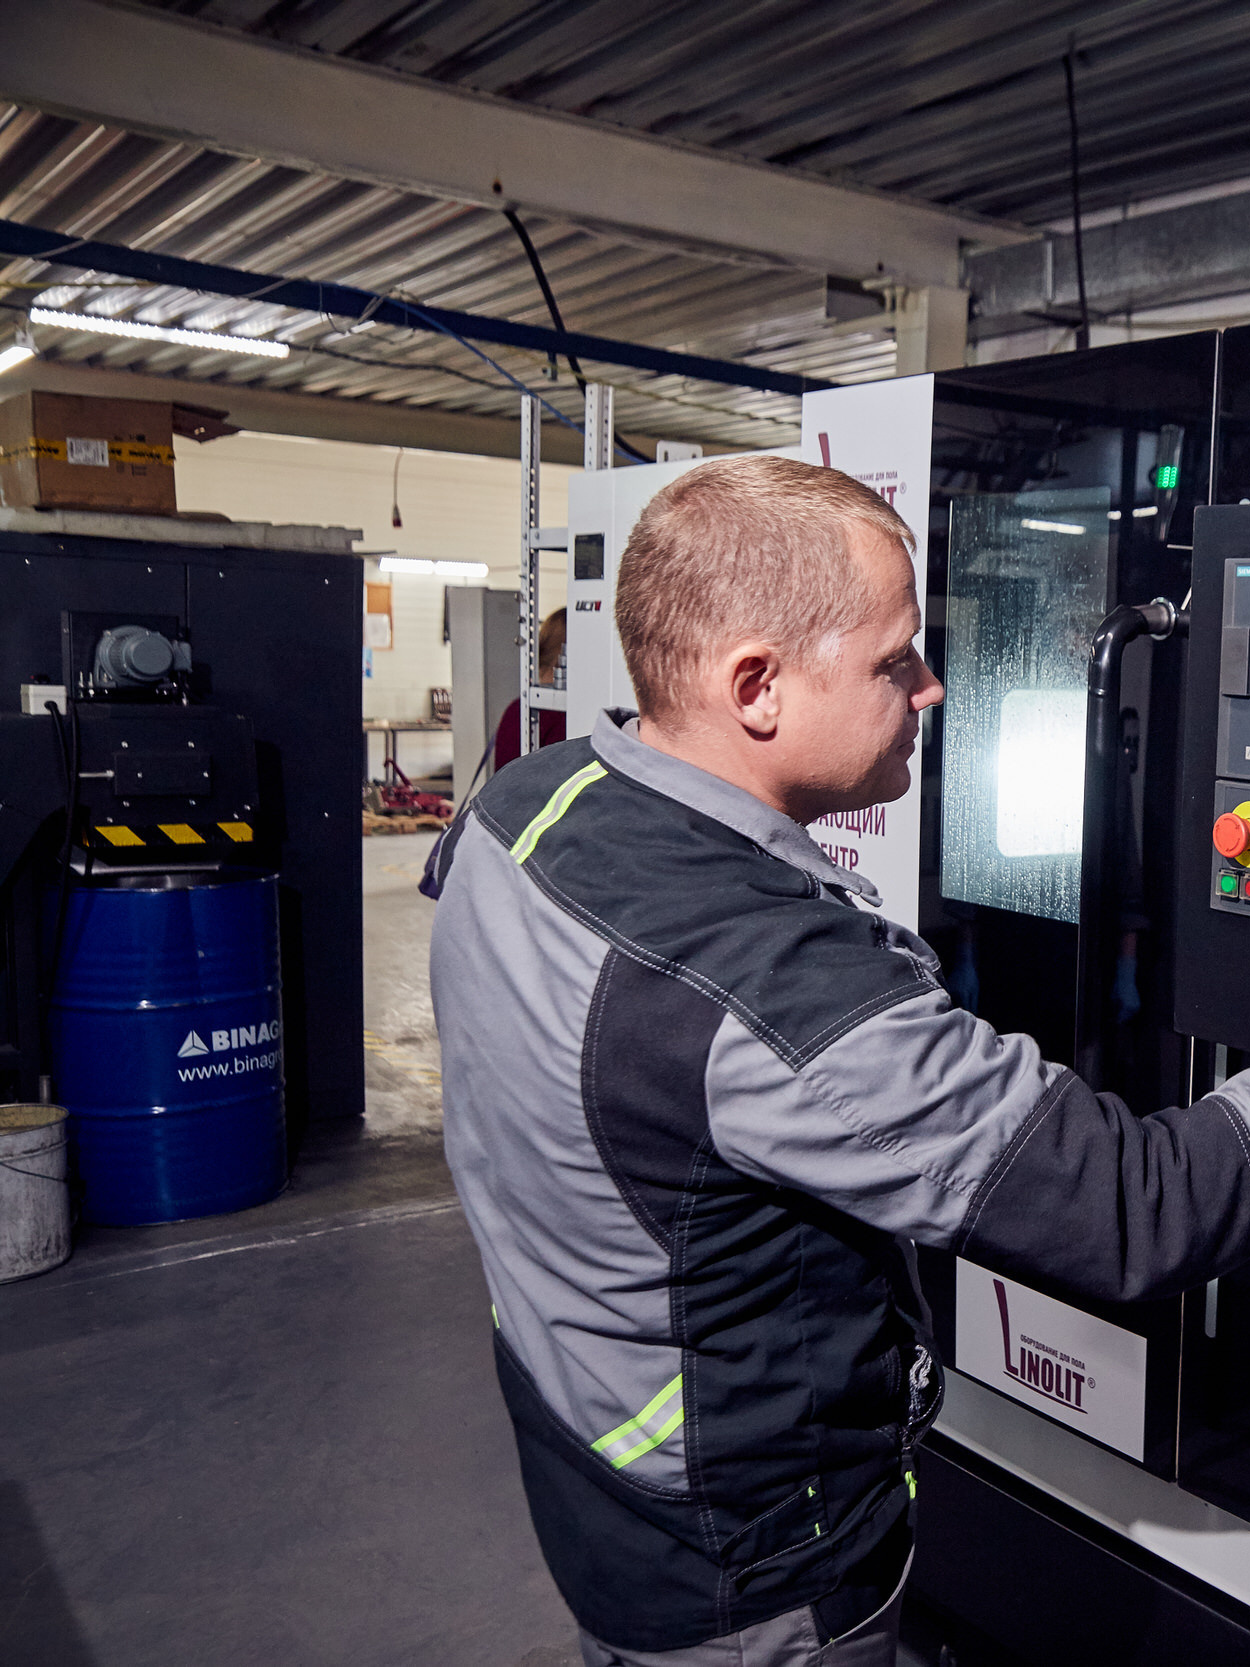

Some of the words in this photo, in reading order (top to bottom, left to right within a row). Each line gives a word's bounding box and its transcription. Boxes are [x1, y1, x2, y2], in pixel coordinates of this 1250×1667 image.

[821, 842, 859, 872] НТР
[1020, 1334, 1058, 1358] ОБОРУДОВАНИЕ
[1059, 1352, 1070, 1363] ДЛЯ
[1071, 1357, 1086, 1370] ПОЛА
